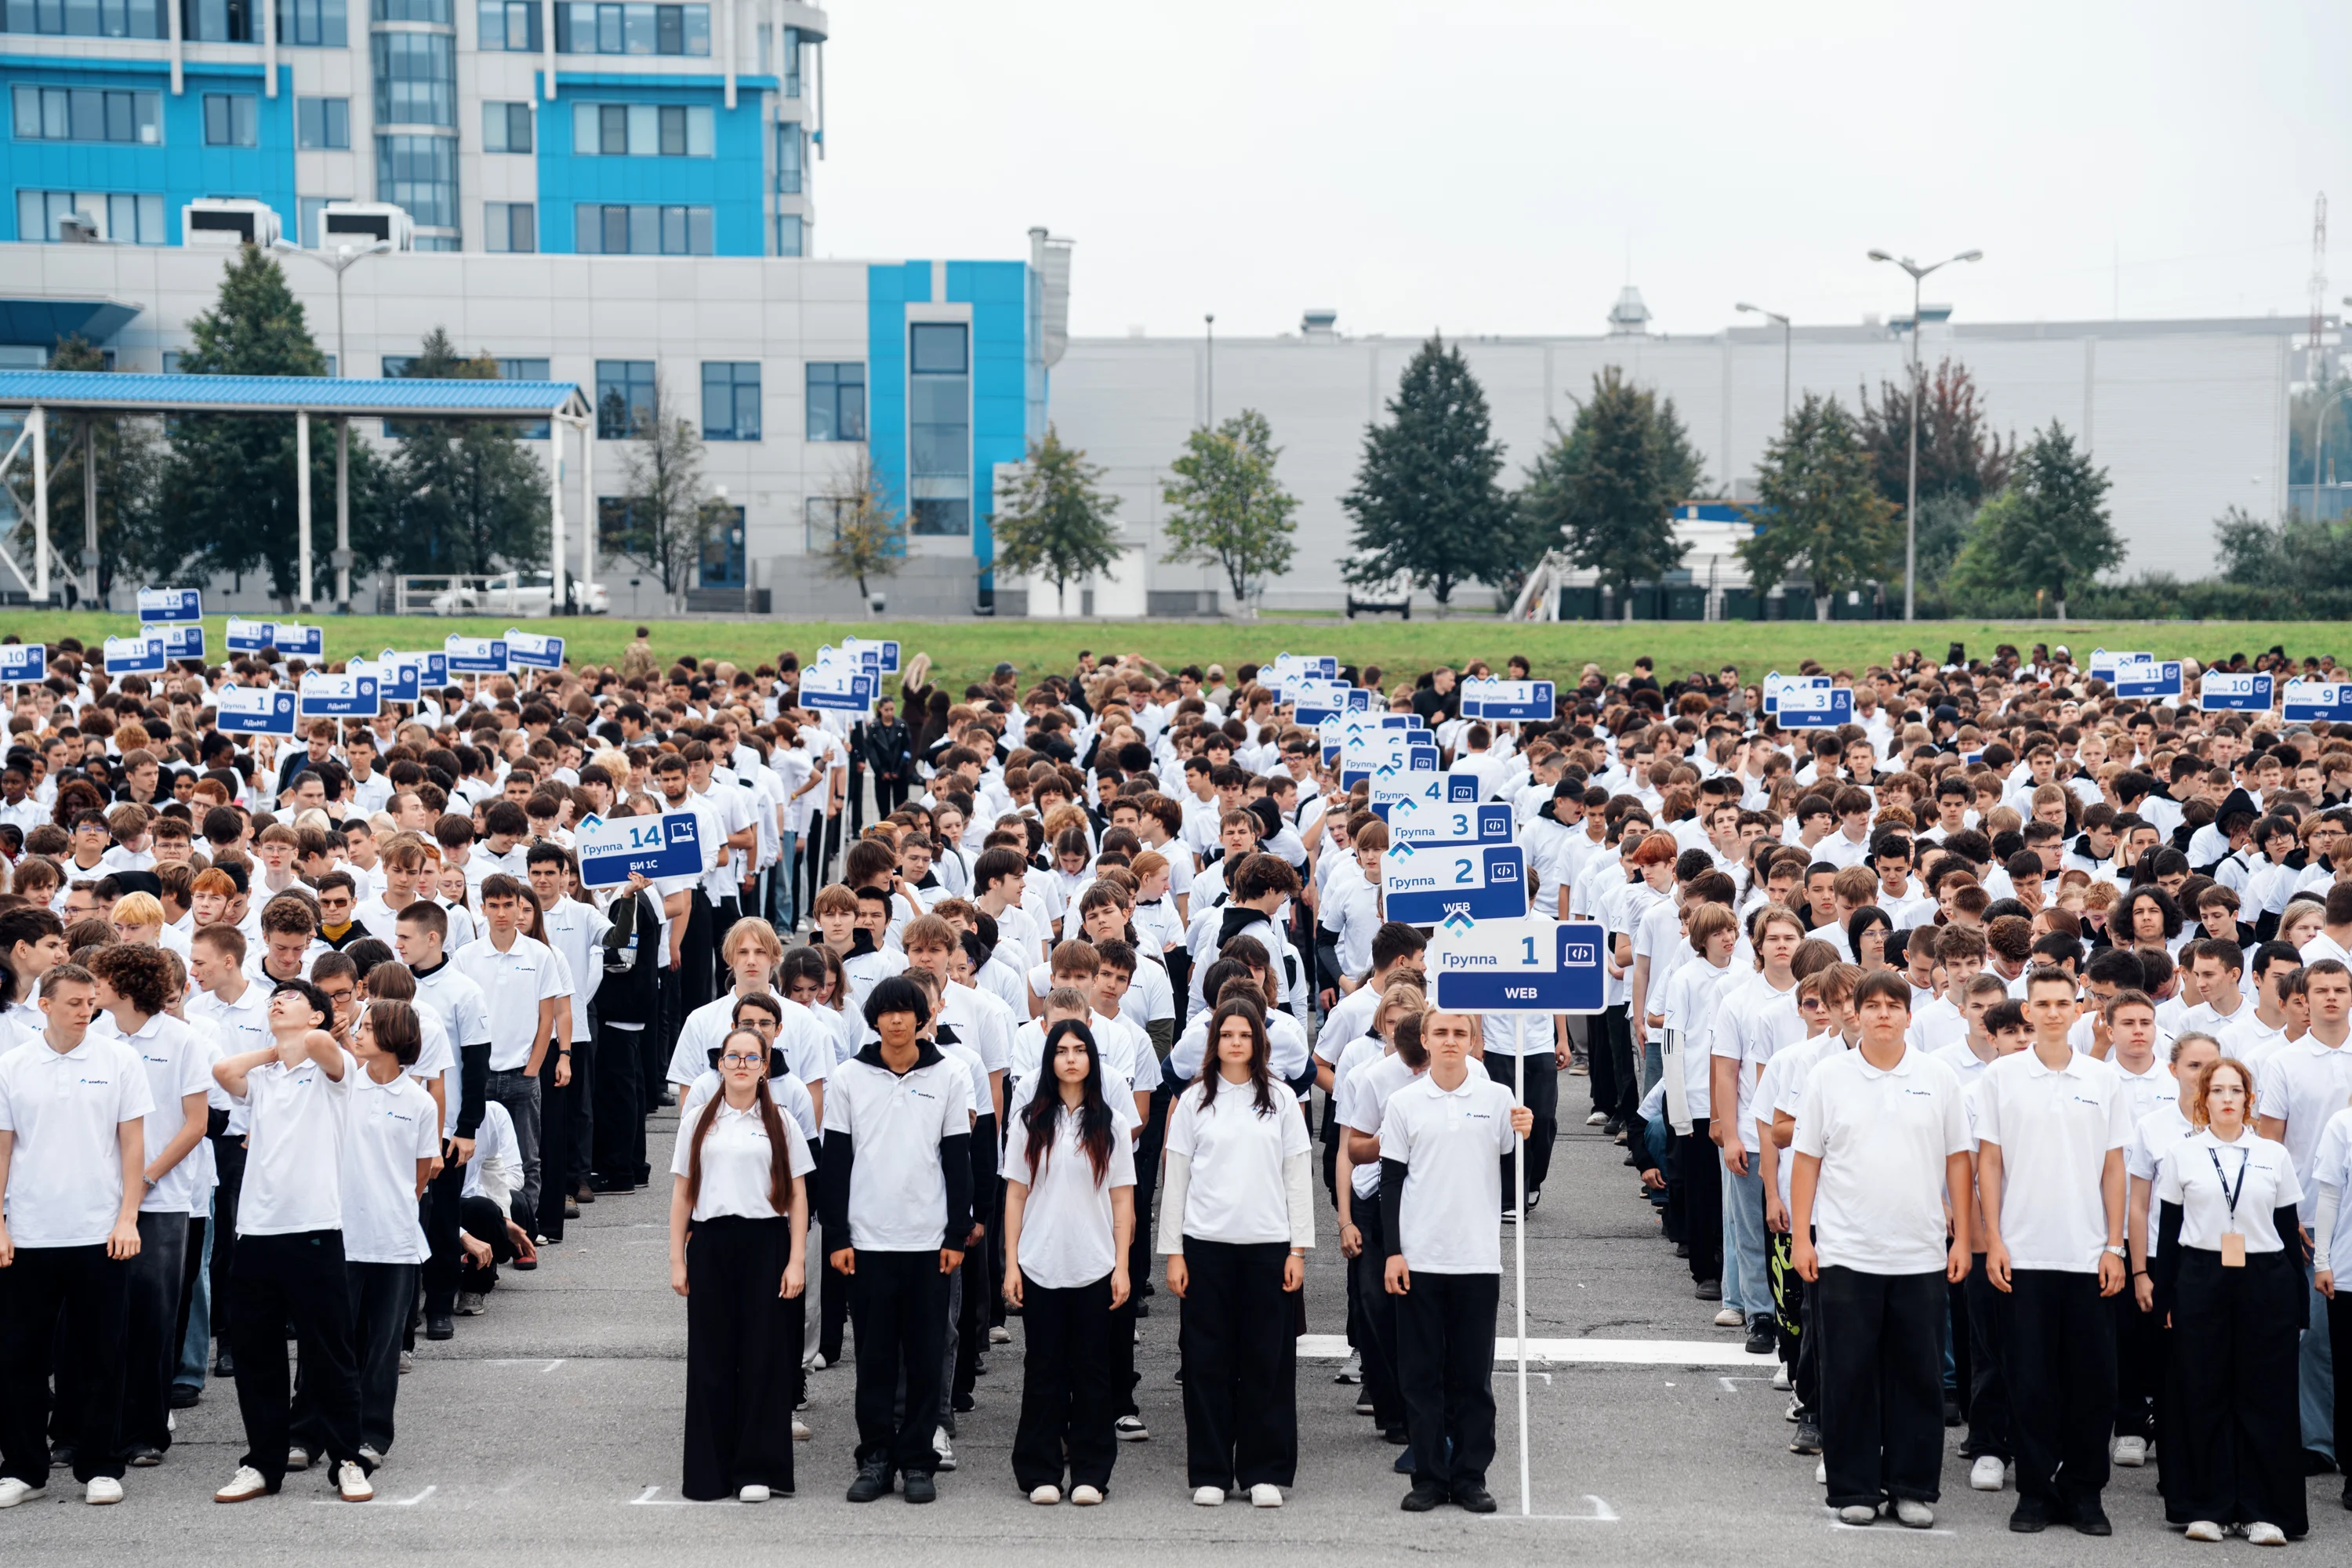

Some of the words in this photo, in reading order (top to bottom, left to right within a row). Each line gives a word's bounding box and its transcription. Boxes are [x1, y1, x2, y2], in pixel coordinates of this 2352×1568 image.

[165, 596, 180, 606] 12
[172, 631, 182, 642] 8
[133, 644, 145, 655] 11
[477, 644, 487, 655] 6
[534, 640, 542, 650] 7
[9, 652, 25, 662] 10
[415, 658, 423, 669] 5
[383, 669, 394, 681] 3
[2147, 668, 2160, 679] 11
[303, 688, 329, 696] Группа
[339, 681, 350, 695] 2
[836, 678, 844, 691] 1
[2231, 680, 2251, 692] 10
[1517, 688, 1525, 700] 1
[2322, 689, 2334, 702] 9
[220, 700, 246, 710] Группа
[256, 696, 265, 710] 1
[1298, 699, 1323, 707] Группа
[1333, 694, 1343, 707] 9
[1816, 695, 1825, 708] 3
[1345, 759, 1377, 769] Группа
[1391, 752, 1403, 769] 5
[1425, 782, 1442, 800] 4
[1395, 827, 1436, 839] Группа
[1452, 814, 1469, 836] 3
[583, 843, 623, 856] Группа
[630, 825, 662, 848] 14
[630, 861, 644, 871] БИ
[1388, 876, 1436, 890] Группа
[1454, 858, 1474, 884] 2
[1443, 902, 1471, 913] WEB
[1442, 952, 1497, 968] Группа
[1522, 936, 1539, 965] 1
[1504, 987, 1538, 999] WEB
